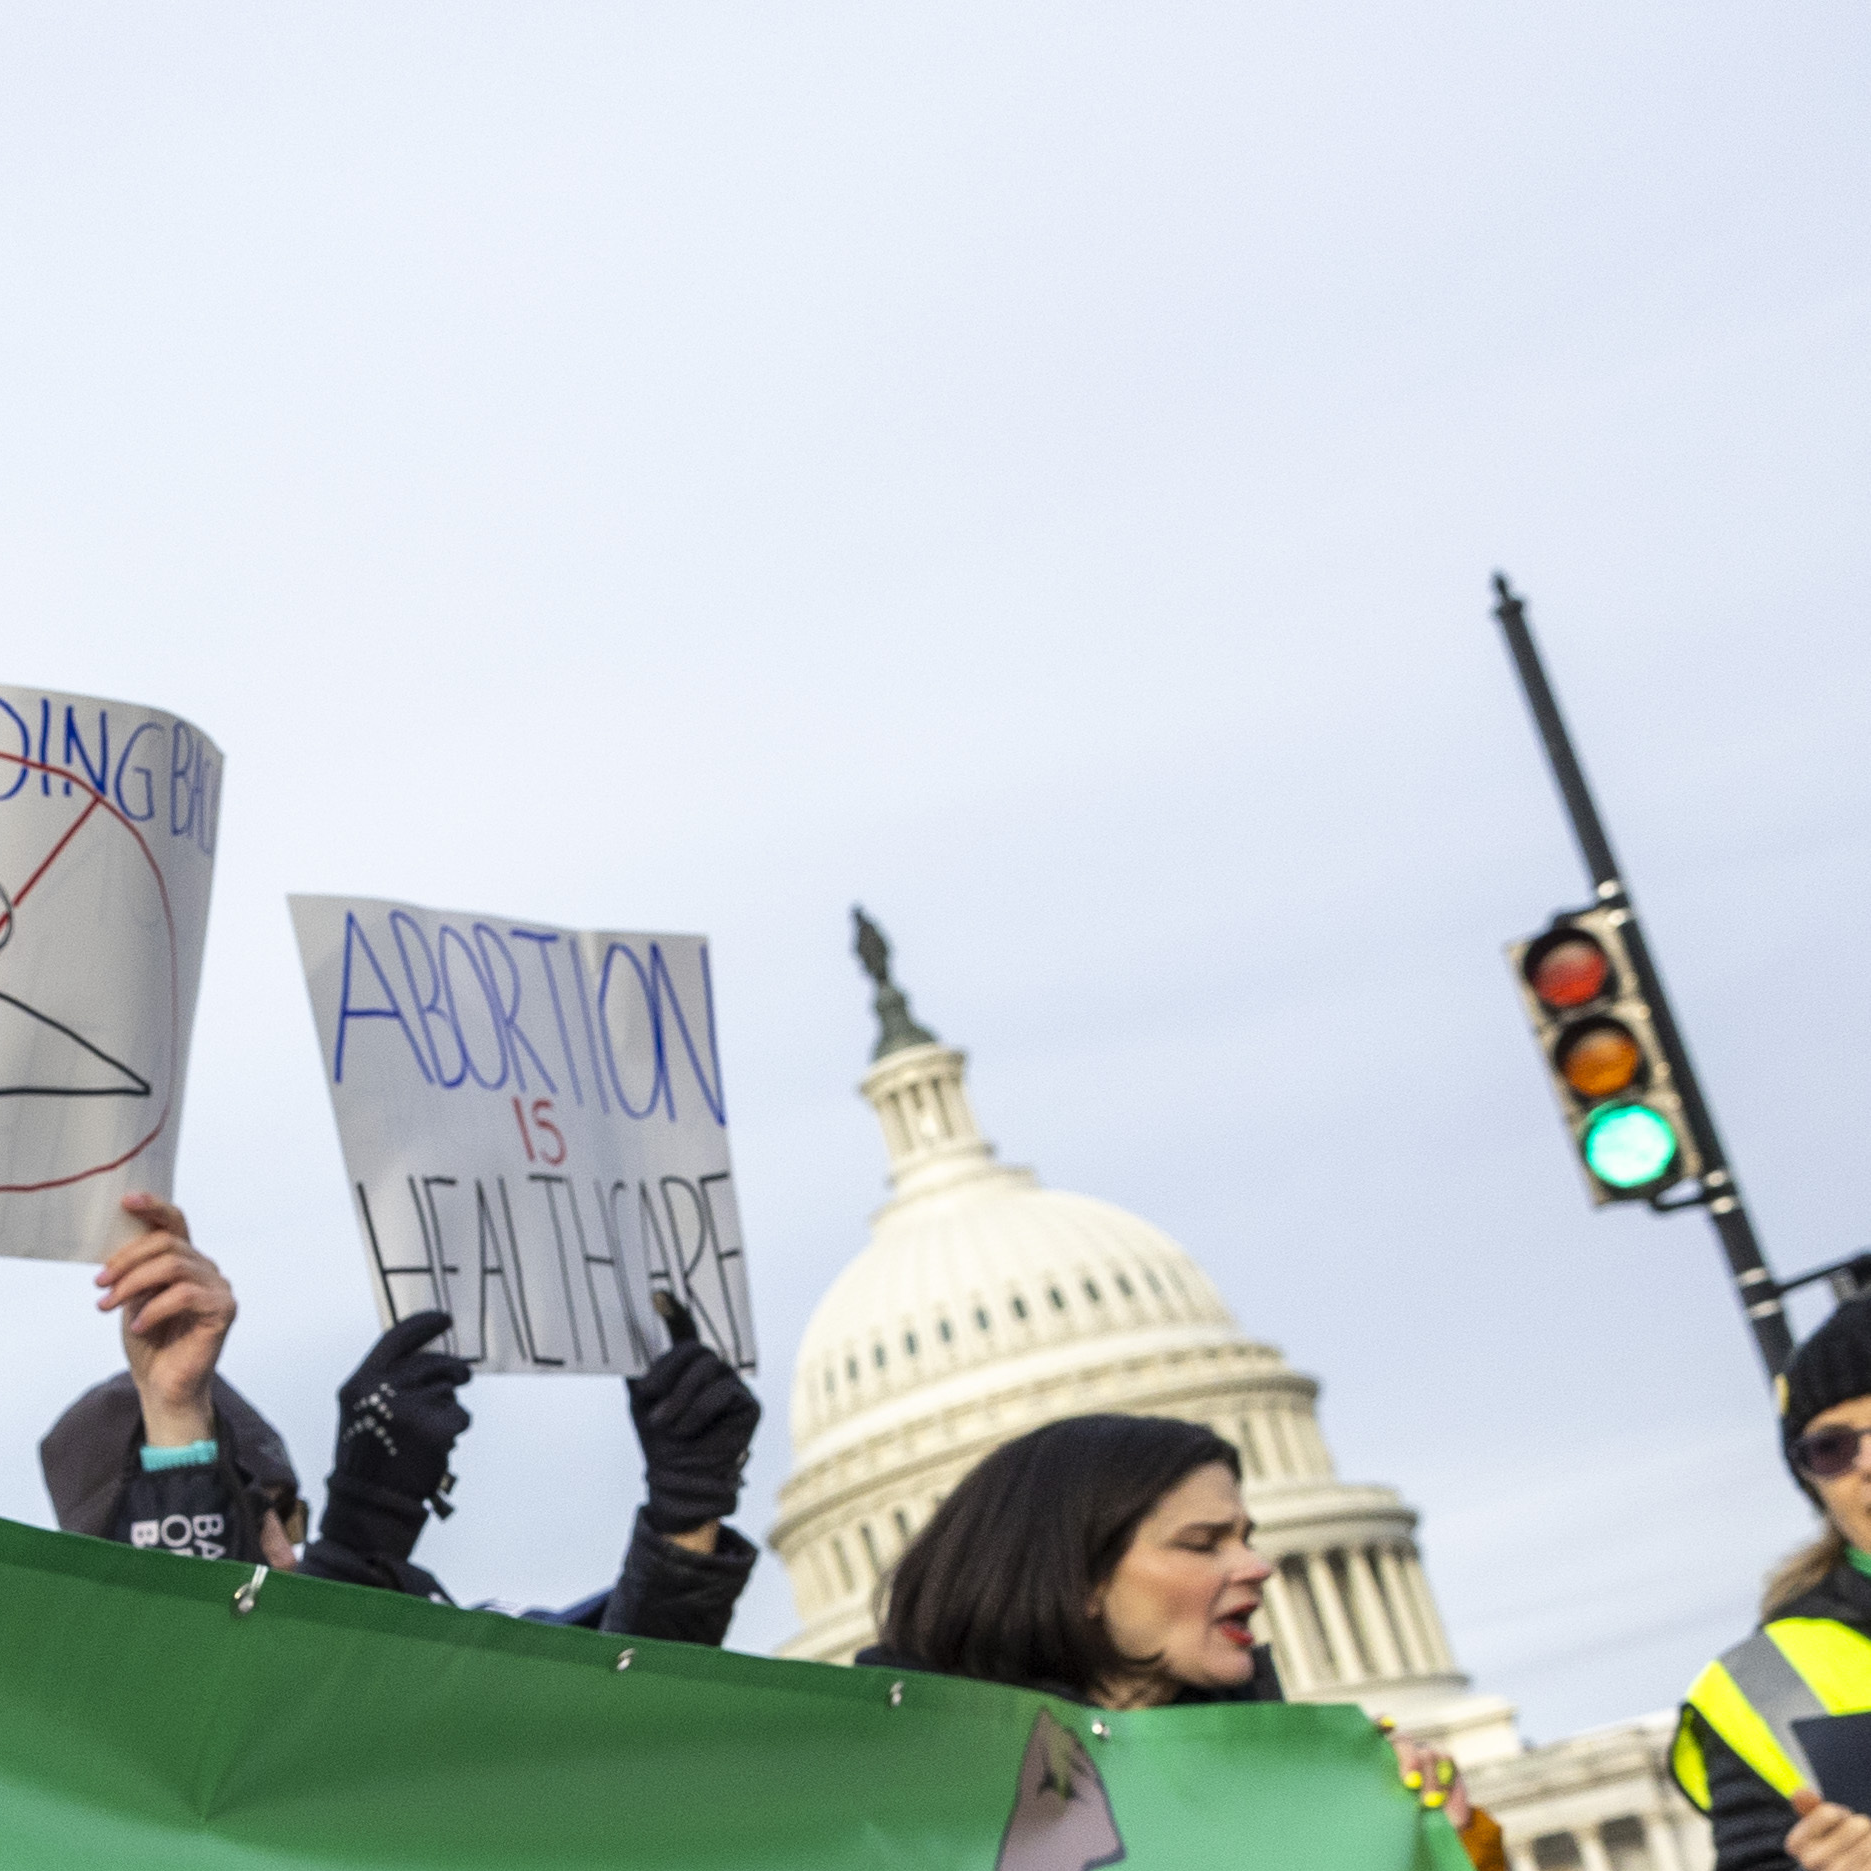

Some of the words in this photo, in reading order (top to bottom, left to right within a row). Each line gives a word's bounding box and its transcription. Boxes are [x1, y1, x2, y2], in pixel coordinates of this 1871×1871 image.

[334, 909, 727, 1128] ABORTION
[512, 1096, 568, 1166] IS
[356, 1171, 757, 1370] HEALTHCARE
